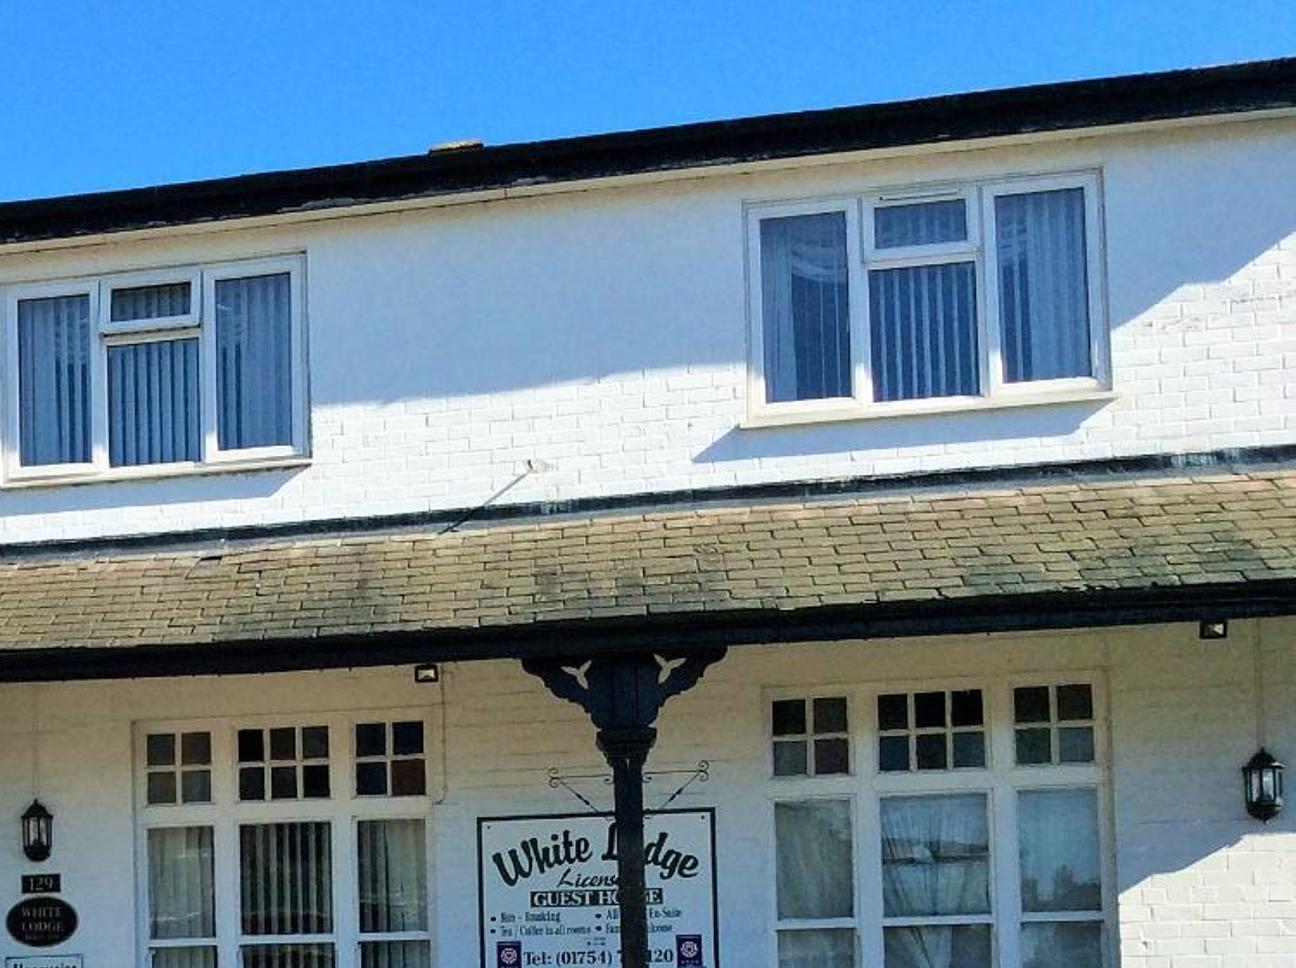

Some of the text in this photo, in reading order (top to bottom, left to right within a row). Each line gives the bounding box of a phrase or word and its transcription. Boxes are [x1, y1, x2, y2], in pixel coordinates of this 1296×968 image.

[492, 822, 698, 887] White Ldge
[30, 877, 54, 892] 129
[533, 892, 593, 908] GUEST
[22, 906, 64, 918] WHITE
[22, 921, 65, 933] LODGE
[524, 951, 553, 966] Tel:
[555, 949, 613, 968] (01754)
